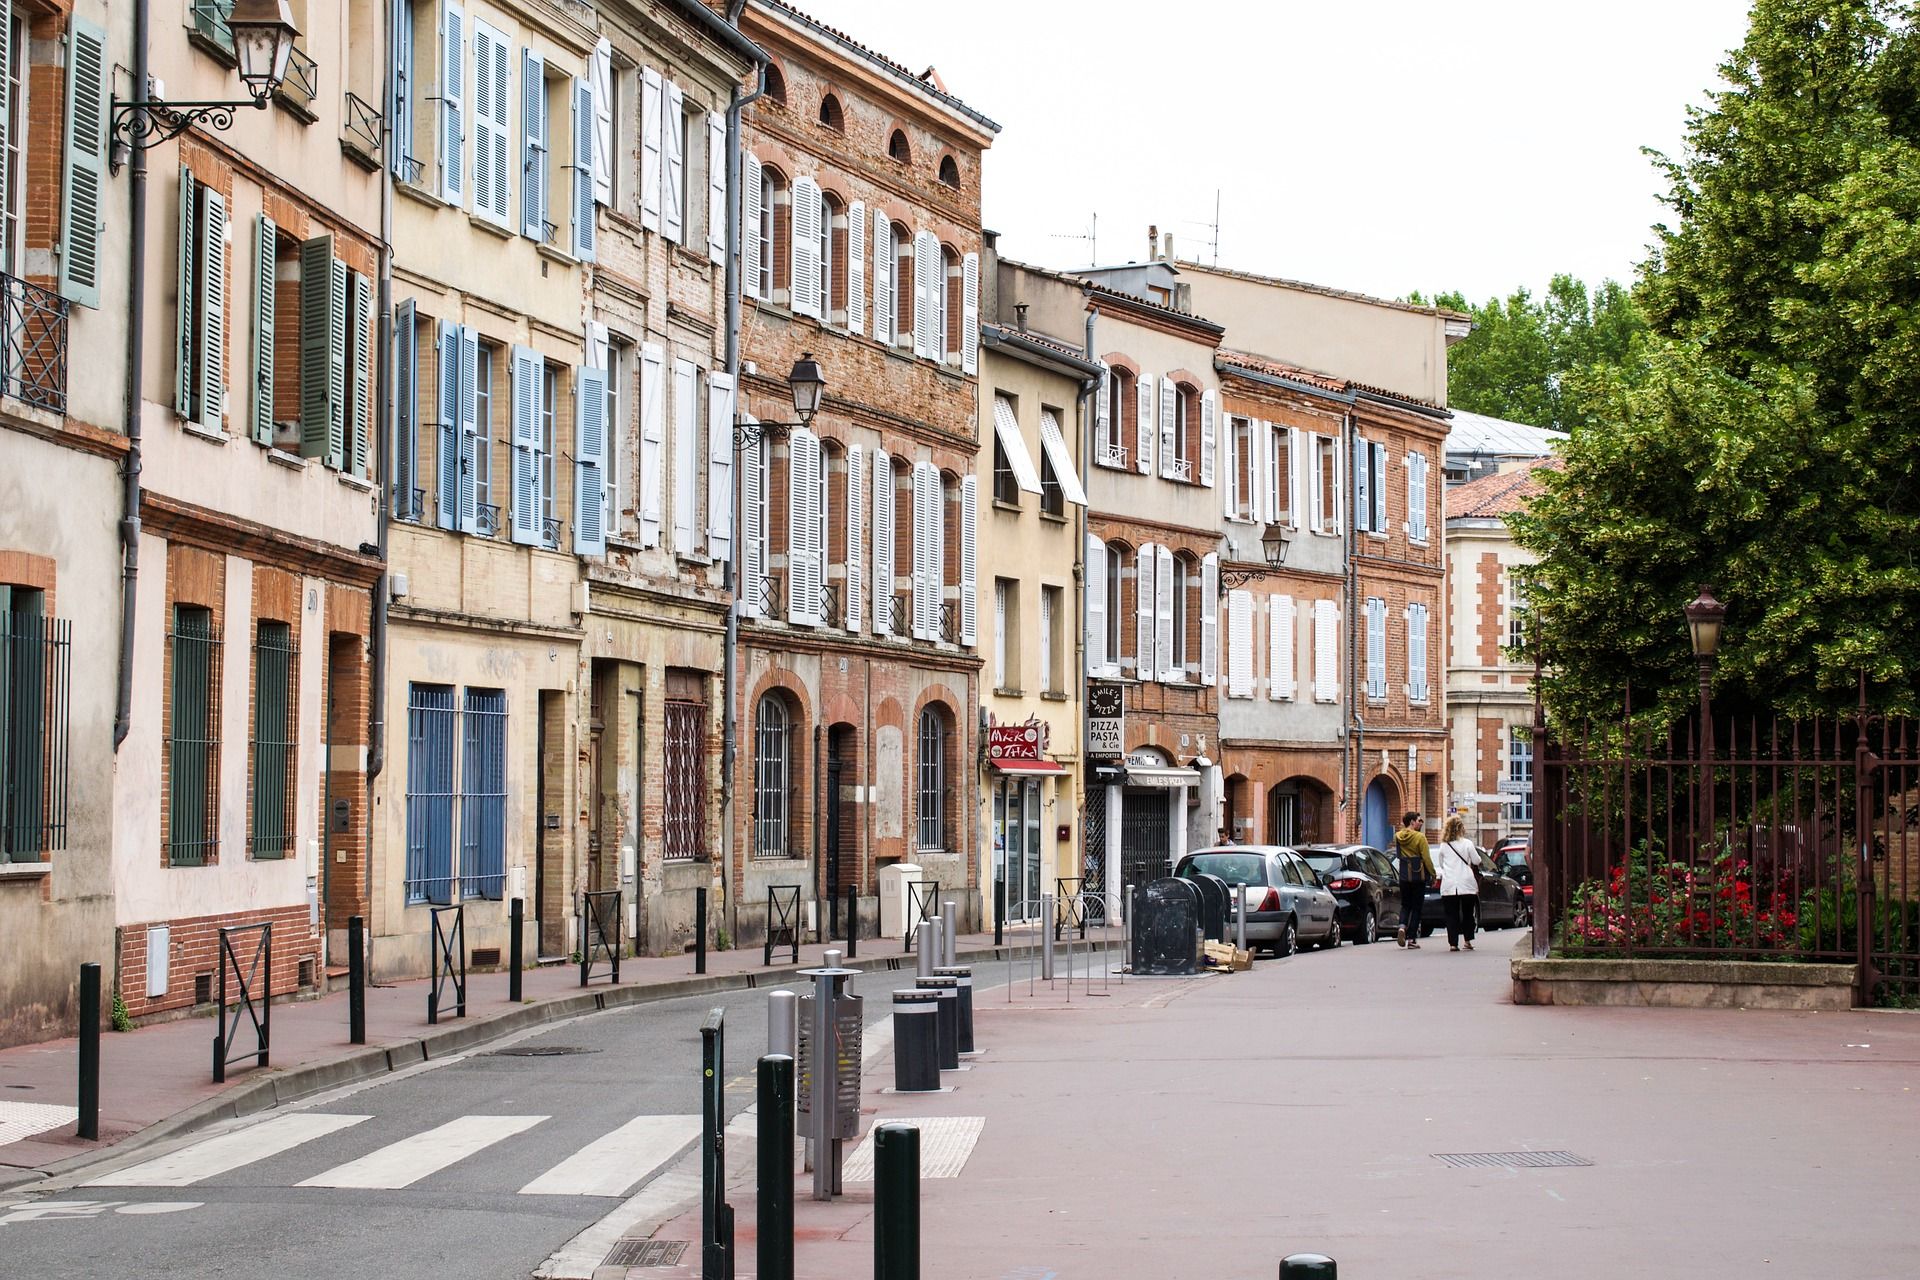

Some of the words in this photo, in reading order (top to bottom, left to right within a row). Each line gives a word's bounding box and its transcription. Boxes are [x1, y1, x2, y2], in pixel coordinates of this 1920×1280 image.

[1092, 687, 1119, 699] EMILE'S
[1094, 703, 1117, 715] PIZZA
[1090, 721, 1119, 731] PIZZA
[1090, 731, 1119, 741] PASTA
[1102, 741, 1107, 749] &
[1109, 741, 1120, 749] Cie
